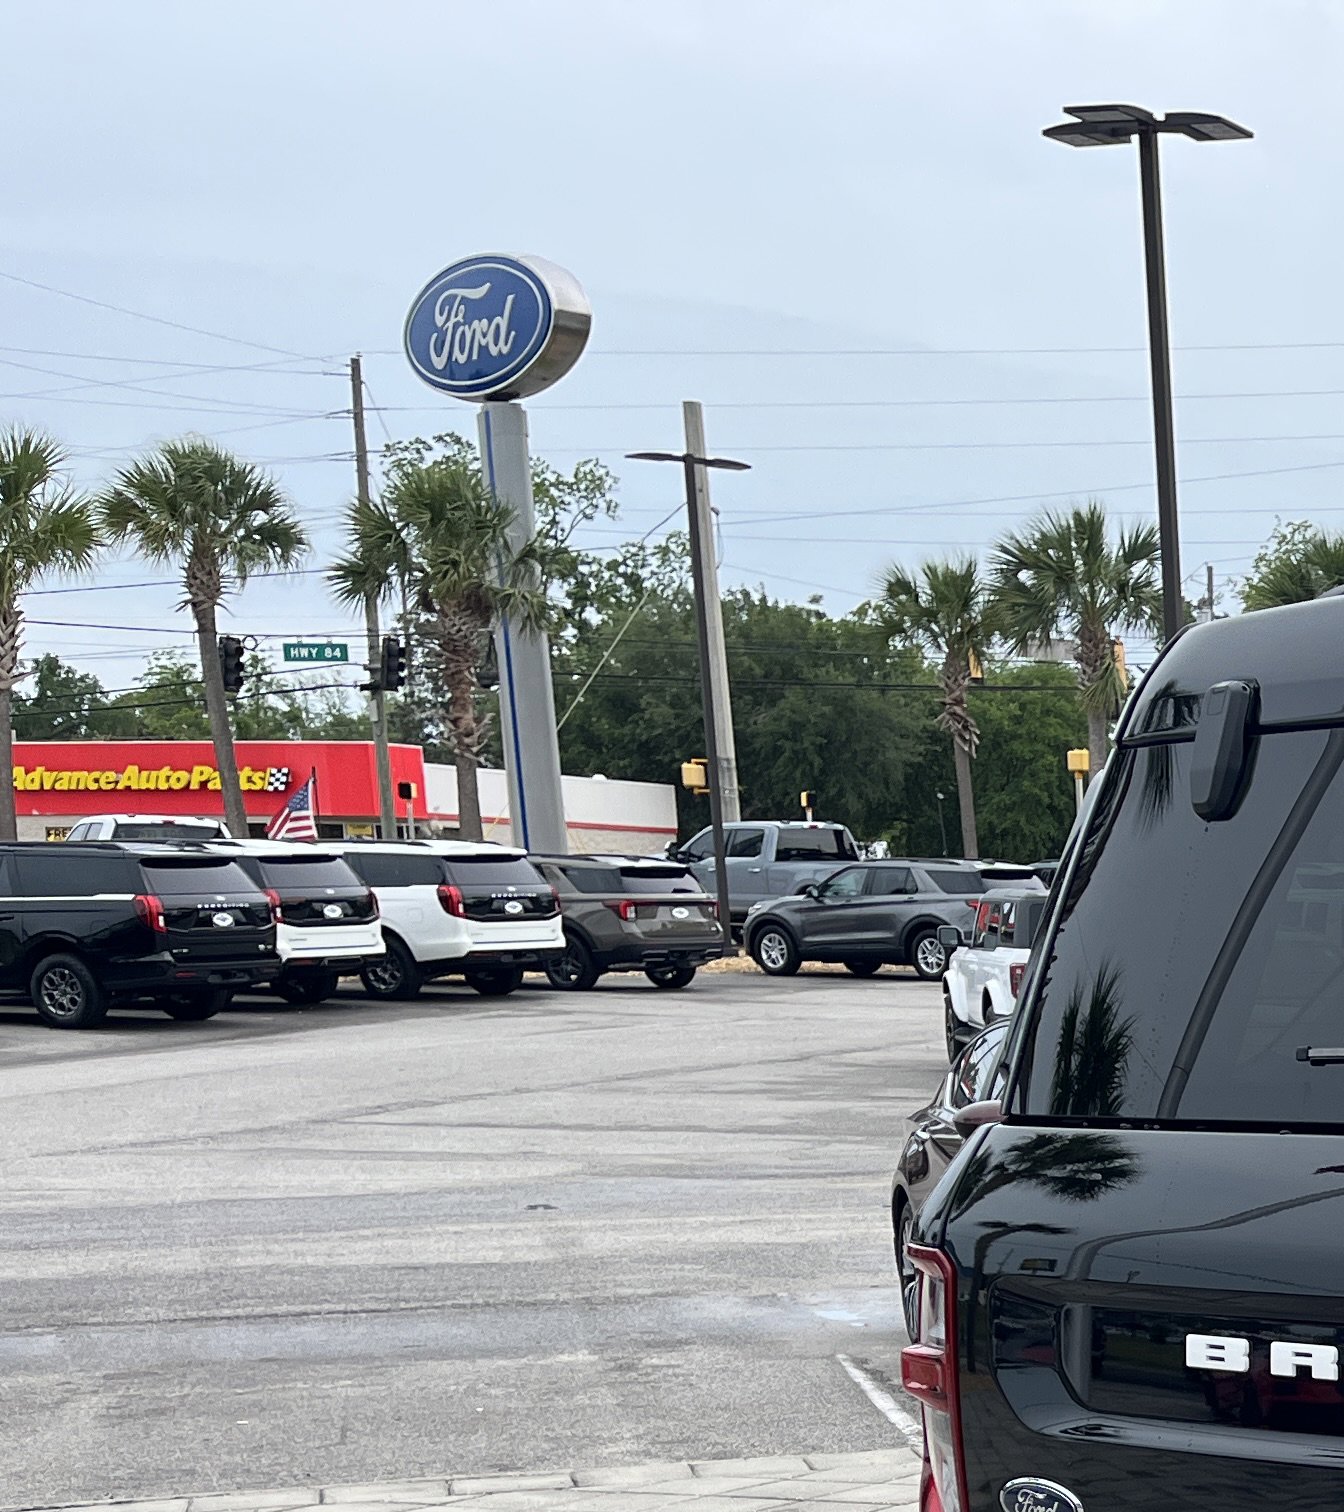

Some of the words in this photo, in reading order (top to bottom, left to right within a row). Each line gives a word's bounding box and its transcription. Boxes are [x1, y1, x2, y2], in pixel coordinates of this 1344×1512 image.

[430, 282, 517, 371] Ford
[290, 647, 318, 659] HWY
[324, 647, 342, 659] 84
[117, 765, 189, 791] Auto
[189, 765, 266, 791] Pats
